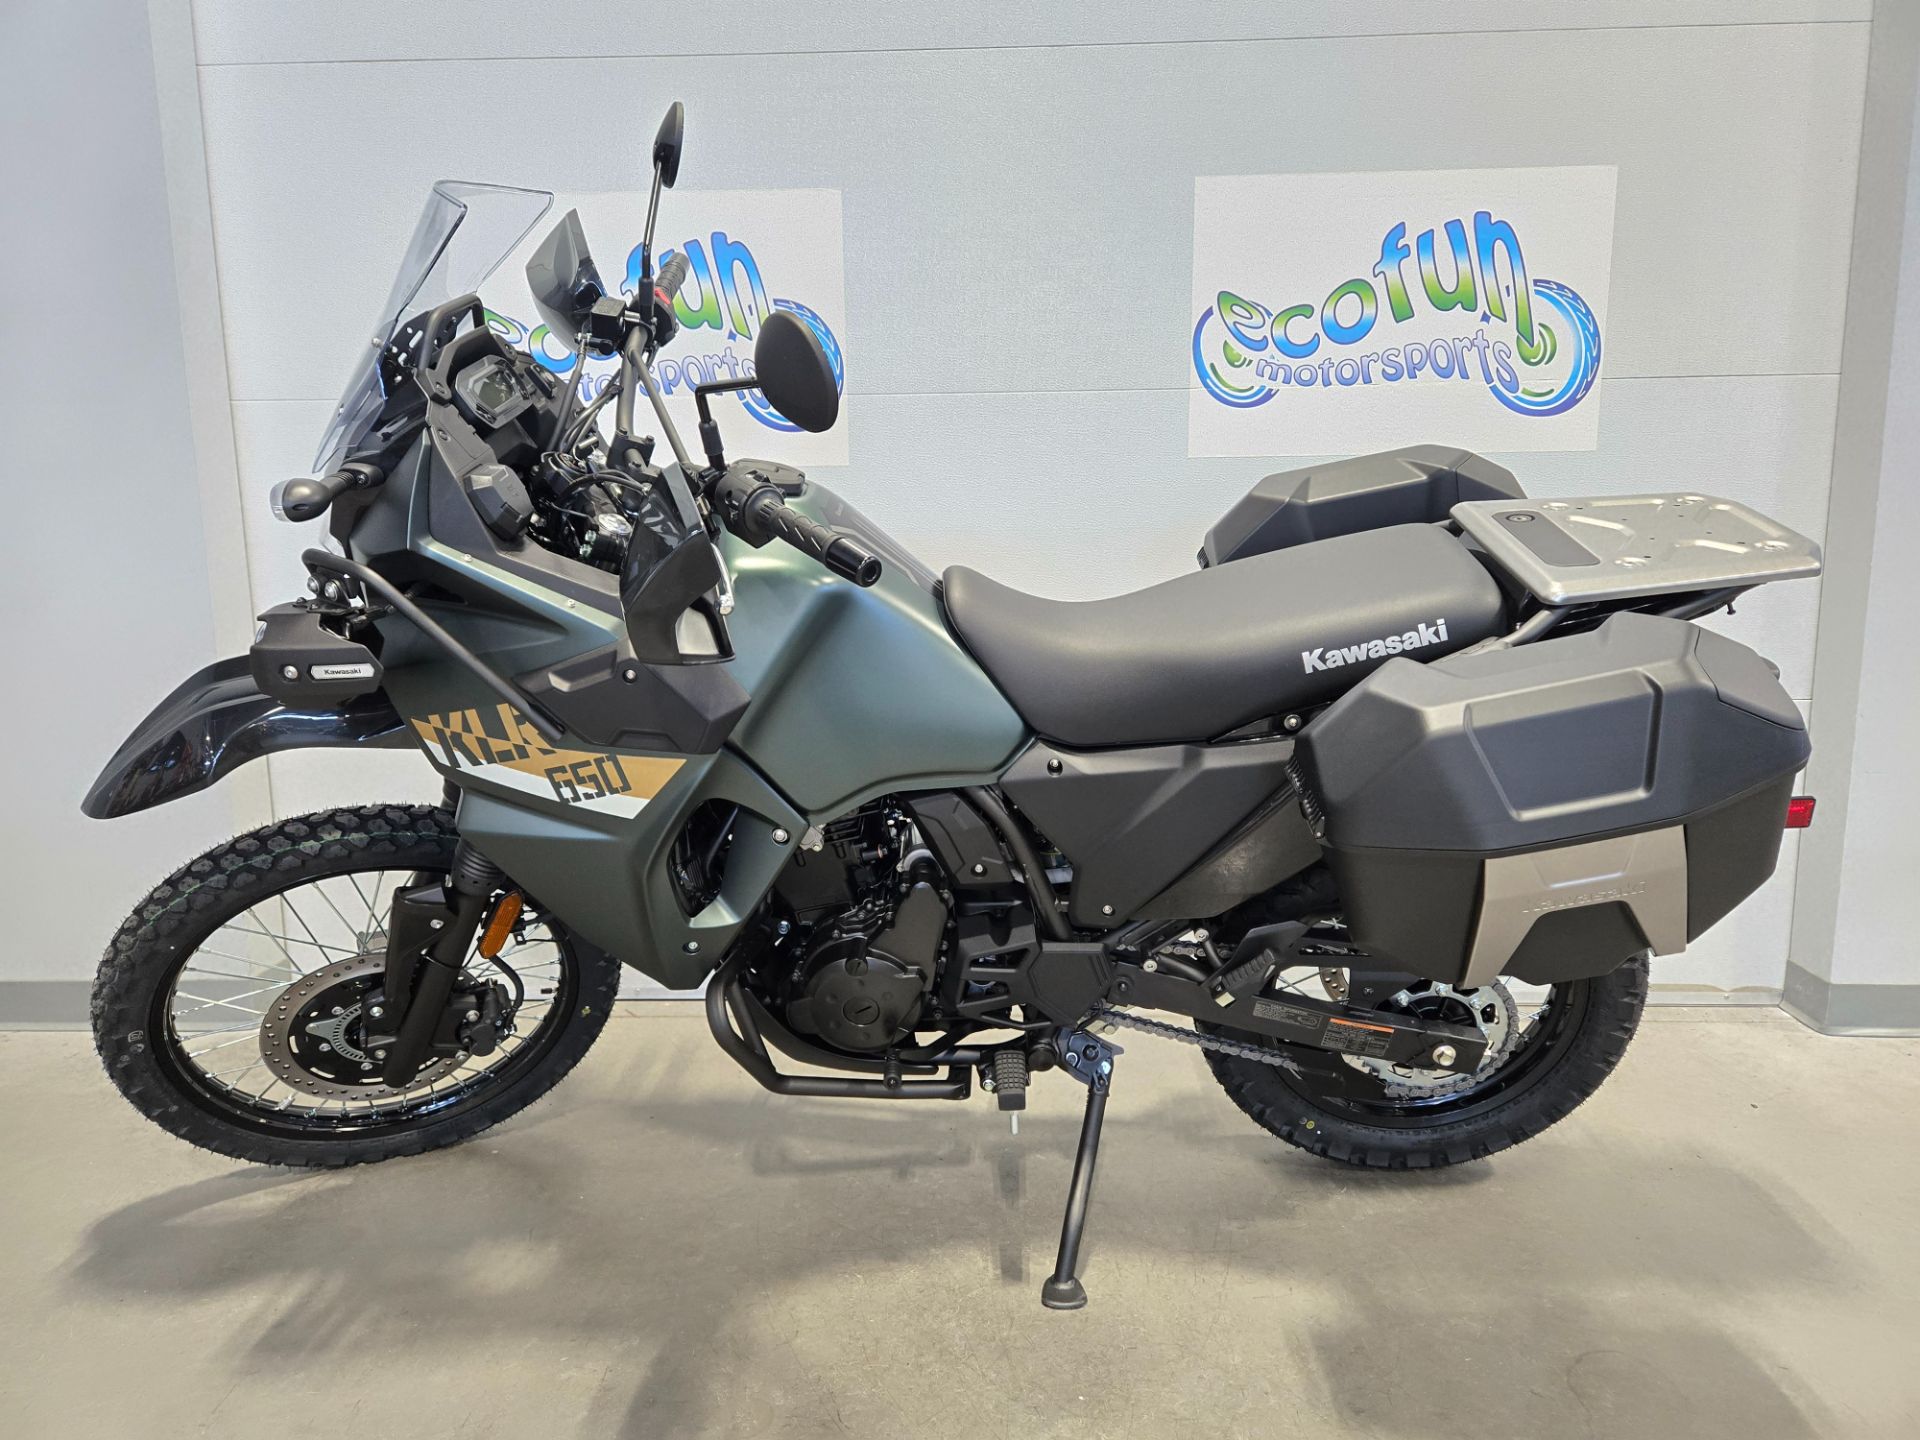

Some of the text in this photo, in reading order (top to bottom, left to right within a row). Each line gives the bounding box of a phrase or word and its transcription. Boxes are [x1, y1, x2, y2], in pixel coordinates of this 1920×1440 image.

[1255, 329, 1520, 394] motorsports
[323, 667, 362, 675] Kawasaki
[1301, 618, 1449, 674] Kawasaki
[544, 754, 632, 804] 650
